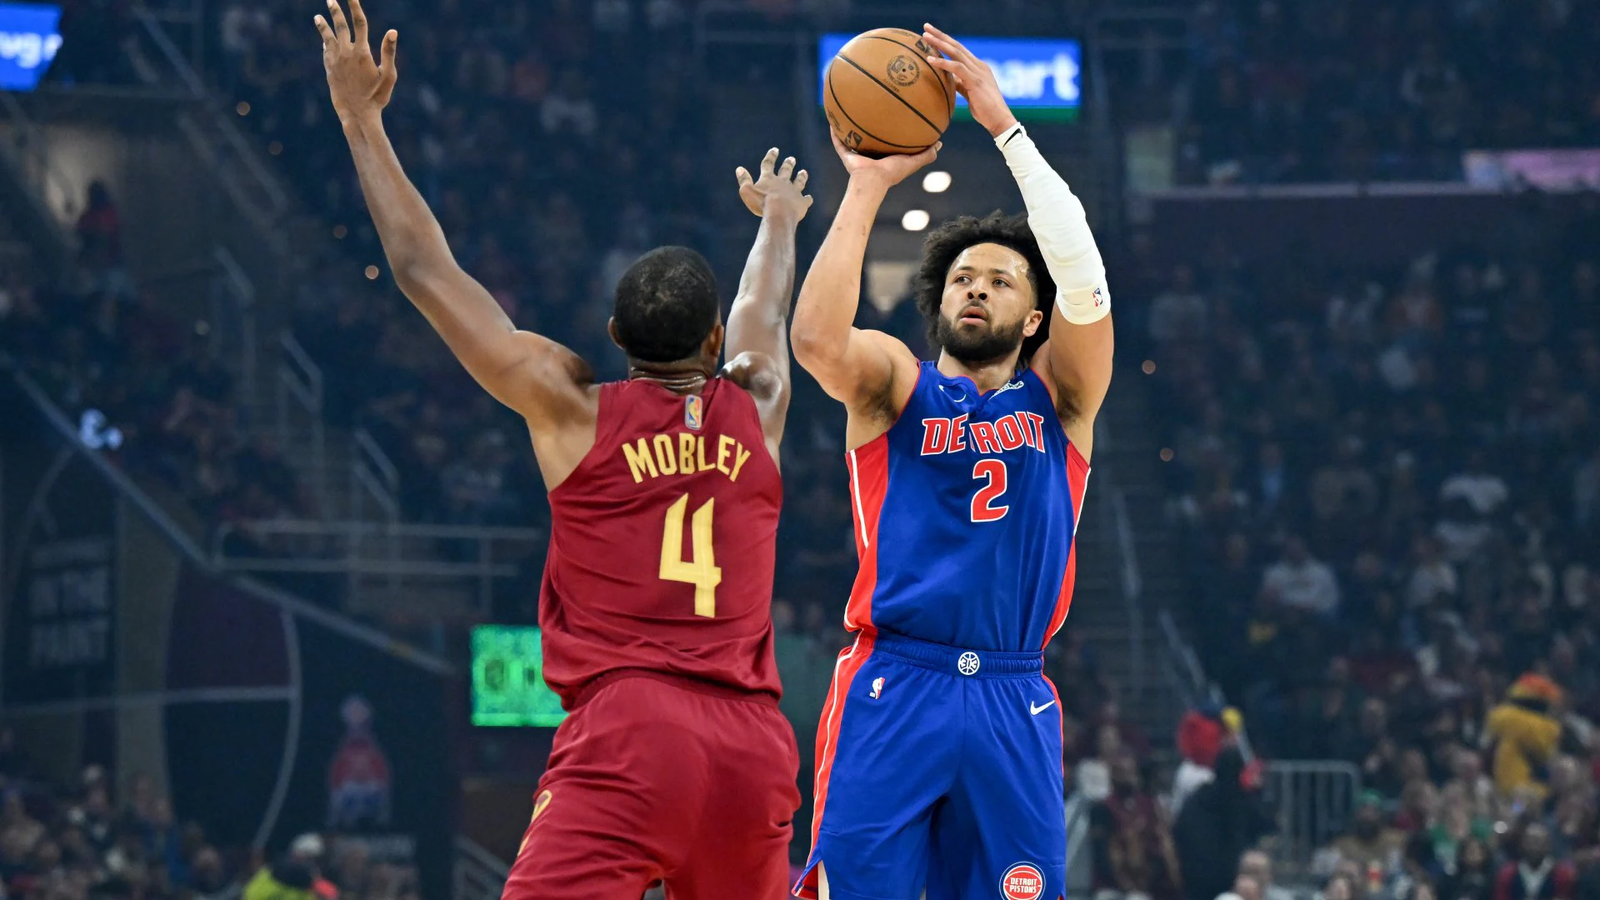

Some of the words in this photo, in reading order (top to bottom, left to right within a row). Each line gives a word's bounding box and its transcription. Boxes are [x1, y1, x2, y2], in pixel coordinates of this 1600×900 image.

[920, 411, 1046, 456] DEROIT
[622, 432, 751, 484] MOBLEY
[971, 458, 1009, 522] 2
[659, 492, 722, 618] 4
[1009, 885, 1037, 894] PISTONS
[1010, 877, 1037, 886] DETROIT
